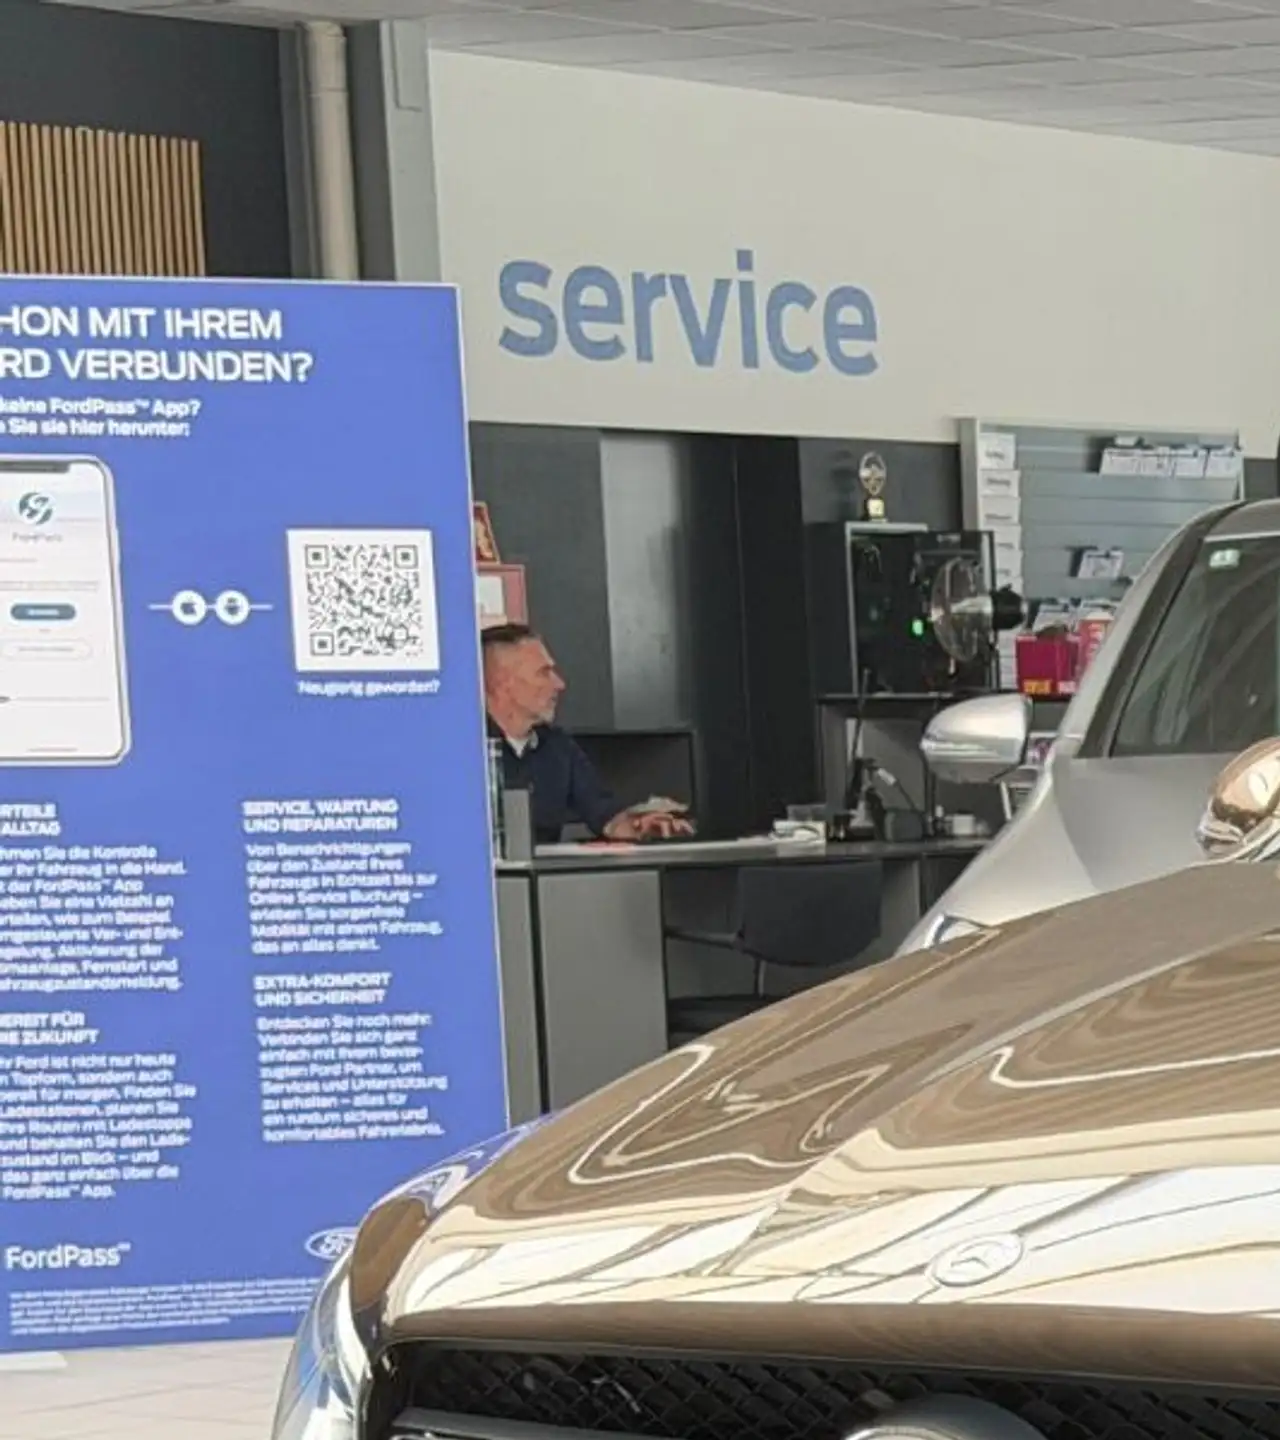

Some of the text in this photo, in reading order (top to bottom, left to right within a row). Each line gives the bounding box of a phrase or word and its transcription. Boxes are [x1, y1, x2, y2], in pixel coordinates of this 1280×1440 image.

[499, 249, 879, 376] service
[88, 306, 156, 338] MIT
[164, 308, 282, 340] IHREM
[58, 350, 313, 382] VERBUNDEN?
[152, 400, 201, 419] App?
[9, 418, 36, 435] Sie
[41, 419, 67, 436] sie
[70, 419, 105, 436] hier
[108, 420, 191, 437] herunter:
[366, 678, 441, 698] geworden?
[243, 799, 399, 817] SERVICE, WARTUNG
[1, 820, 61, 837] ALLTAG
[244, 816, 398, 833] UND REPARATUREN
[43, 844, 157, 860] Sie die Kontrolle
[245, 843, 275, 857] Von
[16, 863, 35, 876] Ihr
[37, 862, 102, 879] Fahrzeug
[104, 861, 118, 875] in
[119, 861, 143, 875] die
[246, 859, 279, 873] über
[281, 859, 309, 872] den
[311, 857, 368, 872] Zustand
[7, 879, 31, 893] der
[113, 877, 144, 895] App
[249, 874, 319, 890] Fahrzeugs
[321, 874, 335, 888] in
[38, 893, 174, 910] Sie eine Vielzahl an
[250, 888, 411, 905] Online Service Buchung
[53, 910, 171, 925] wie zum Beispiel
[250, 906, 304, 920] erleben
[306, 906, 327, 920] Sie
[91, 927, 121, 941] Ver-
[123, 928, 152, 940] und
[312, 922, 335, 935] mit
[338, 921, 378, 935] einem
[380, 920, 443, 936] Fahrzeug,
[57, 942, 163, 959] Aktivierung der
[253, 937, 380, 953] das an alles denkt.
[81, 957, 178, 974] Fernstart und
[254, 972, 393, 990] EXTRA-KOMFORT
[255, 989, 387, 1007] UND SICHERHEIT
[51, 1010, 85, 1027] FÜR
[258, 1016, 330, 1031] Entdecken
[332, 1014, 354, 1029] Sie
[357, 1014, 390, 1027] noch
[22, 1028, 99, 1045] ZUKUNFT
[258, 1029, 417, 1047] Verbinden Sie sich ganz
[15, 1053, 176, 1069] Ford ist nicht nur heute
[259, 1047, 310, 1062] einfach
[313, 1047, 336, 1061] mit
[338, 1045, 378, 1060] Ihrem
[310, 1062, 342, 1077] Ford
[399, 1061, 422, 1073] um
[10, 1068, 173, 1088] Topform, sondern auch
[263, 1075, 449, 1095] Services und Unterstützung
[40, 1085, 62, 1101] für
[123, 1084, 172, 1099] Finden
[174, 1082, 196, 1098] Sie
[105, 1102, 154, 1117] planen
[156, 1100, 179, 1115] Sie
[262, 1091, 408, 1110] zu erhalten alles für
[263, 1106, 429, 1126] ein rundum sicheres und
[29, 1118, 80, 1134] Routen
[82, 1118, 107, 1133] mit
[108, 1116, 192, 1133] Ladestopps
[0, 1131, 190, 1151] und behalten Sie den Lade-
[263, 1126, 356, 1142] komfortables
[1, 1149, 159, 1167] zustand im Blick und
[3, 1164, 179, 1184] das ganz einfach über die
[81, 1183, 116, 1200] App.
